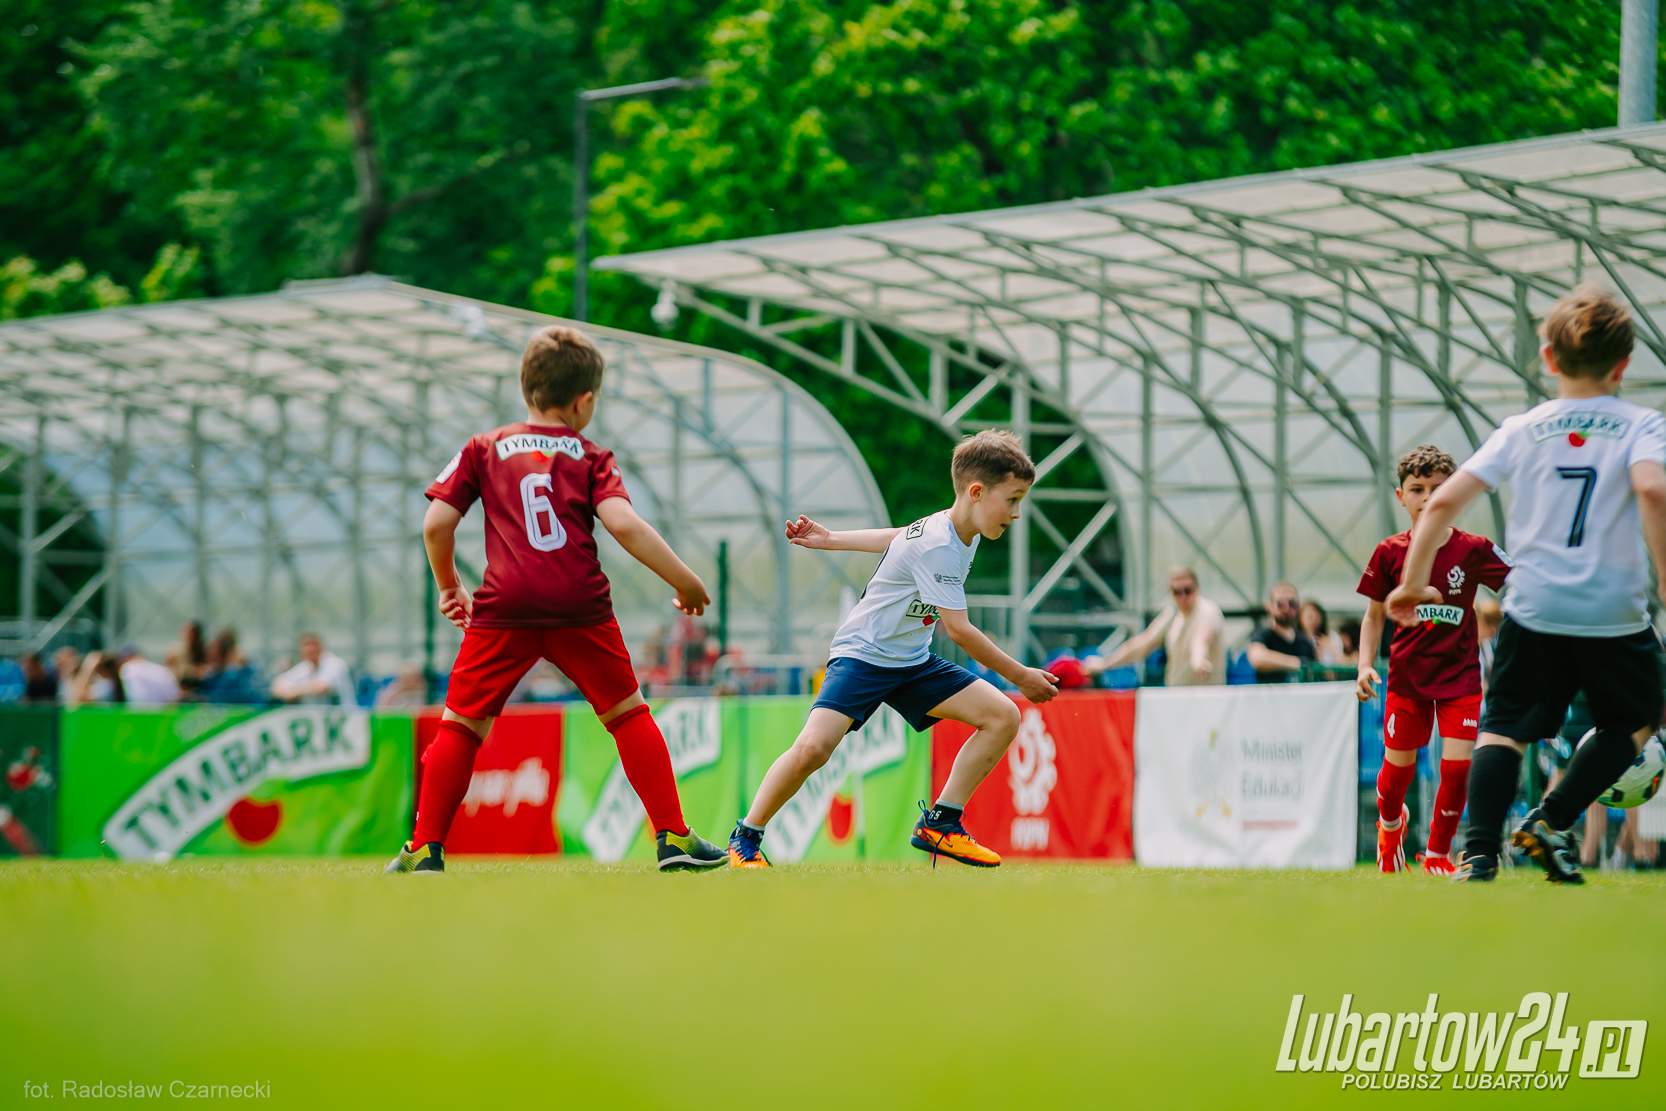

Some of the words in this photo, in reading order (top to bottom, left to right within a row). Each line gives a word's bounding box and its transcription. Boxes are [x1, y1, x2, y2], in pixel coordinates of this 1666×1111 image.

[520, 473, 567, 552] 6
[1556, 466, 1597, 548] 7
[1417, 606, 1461, 622] MBARK
[122, 710, 356, 851] TYMBARK
